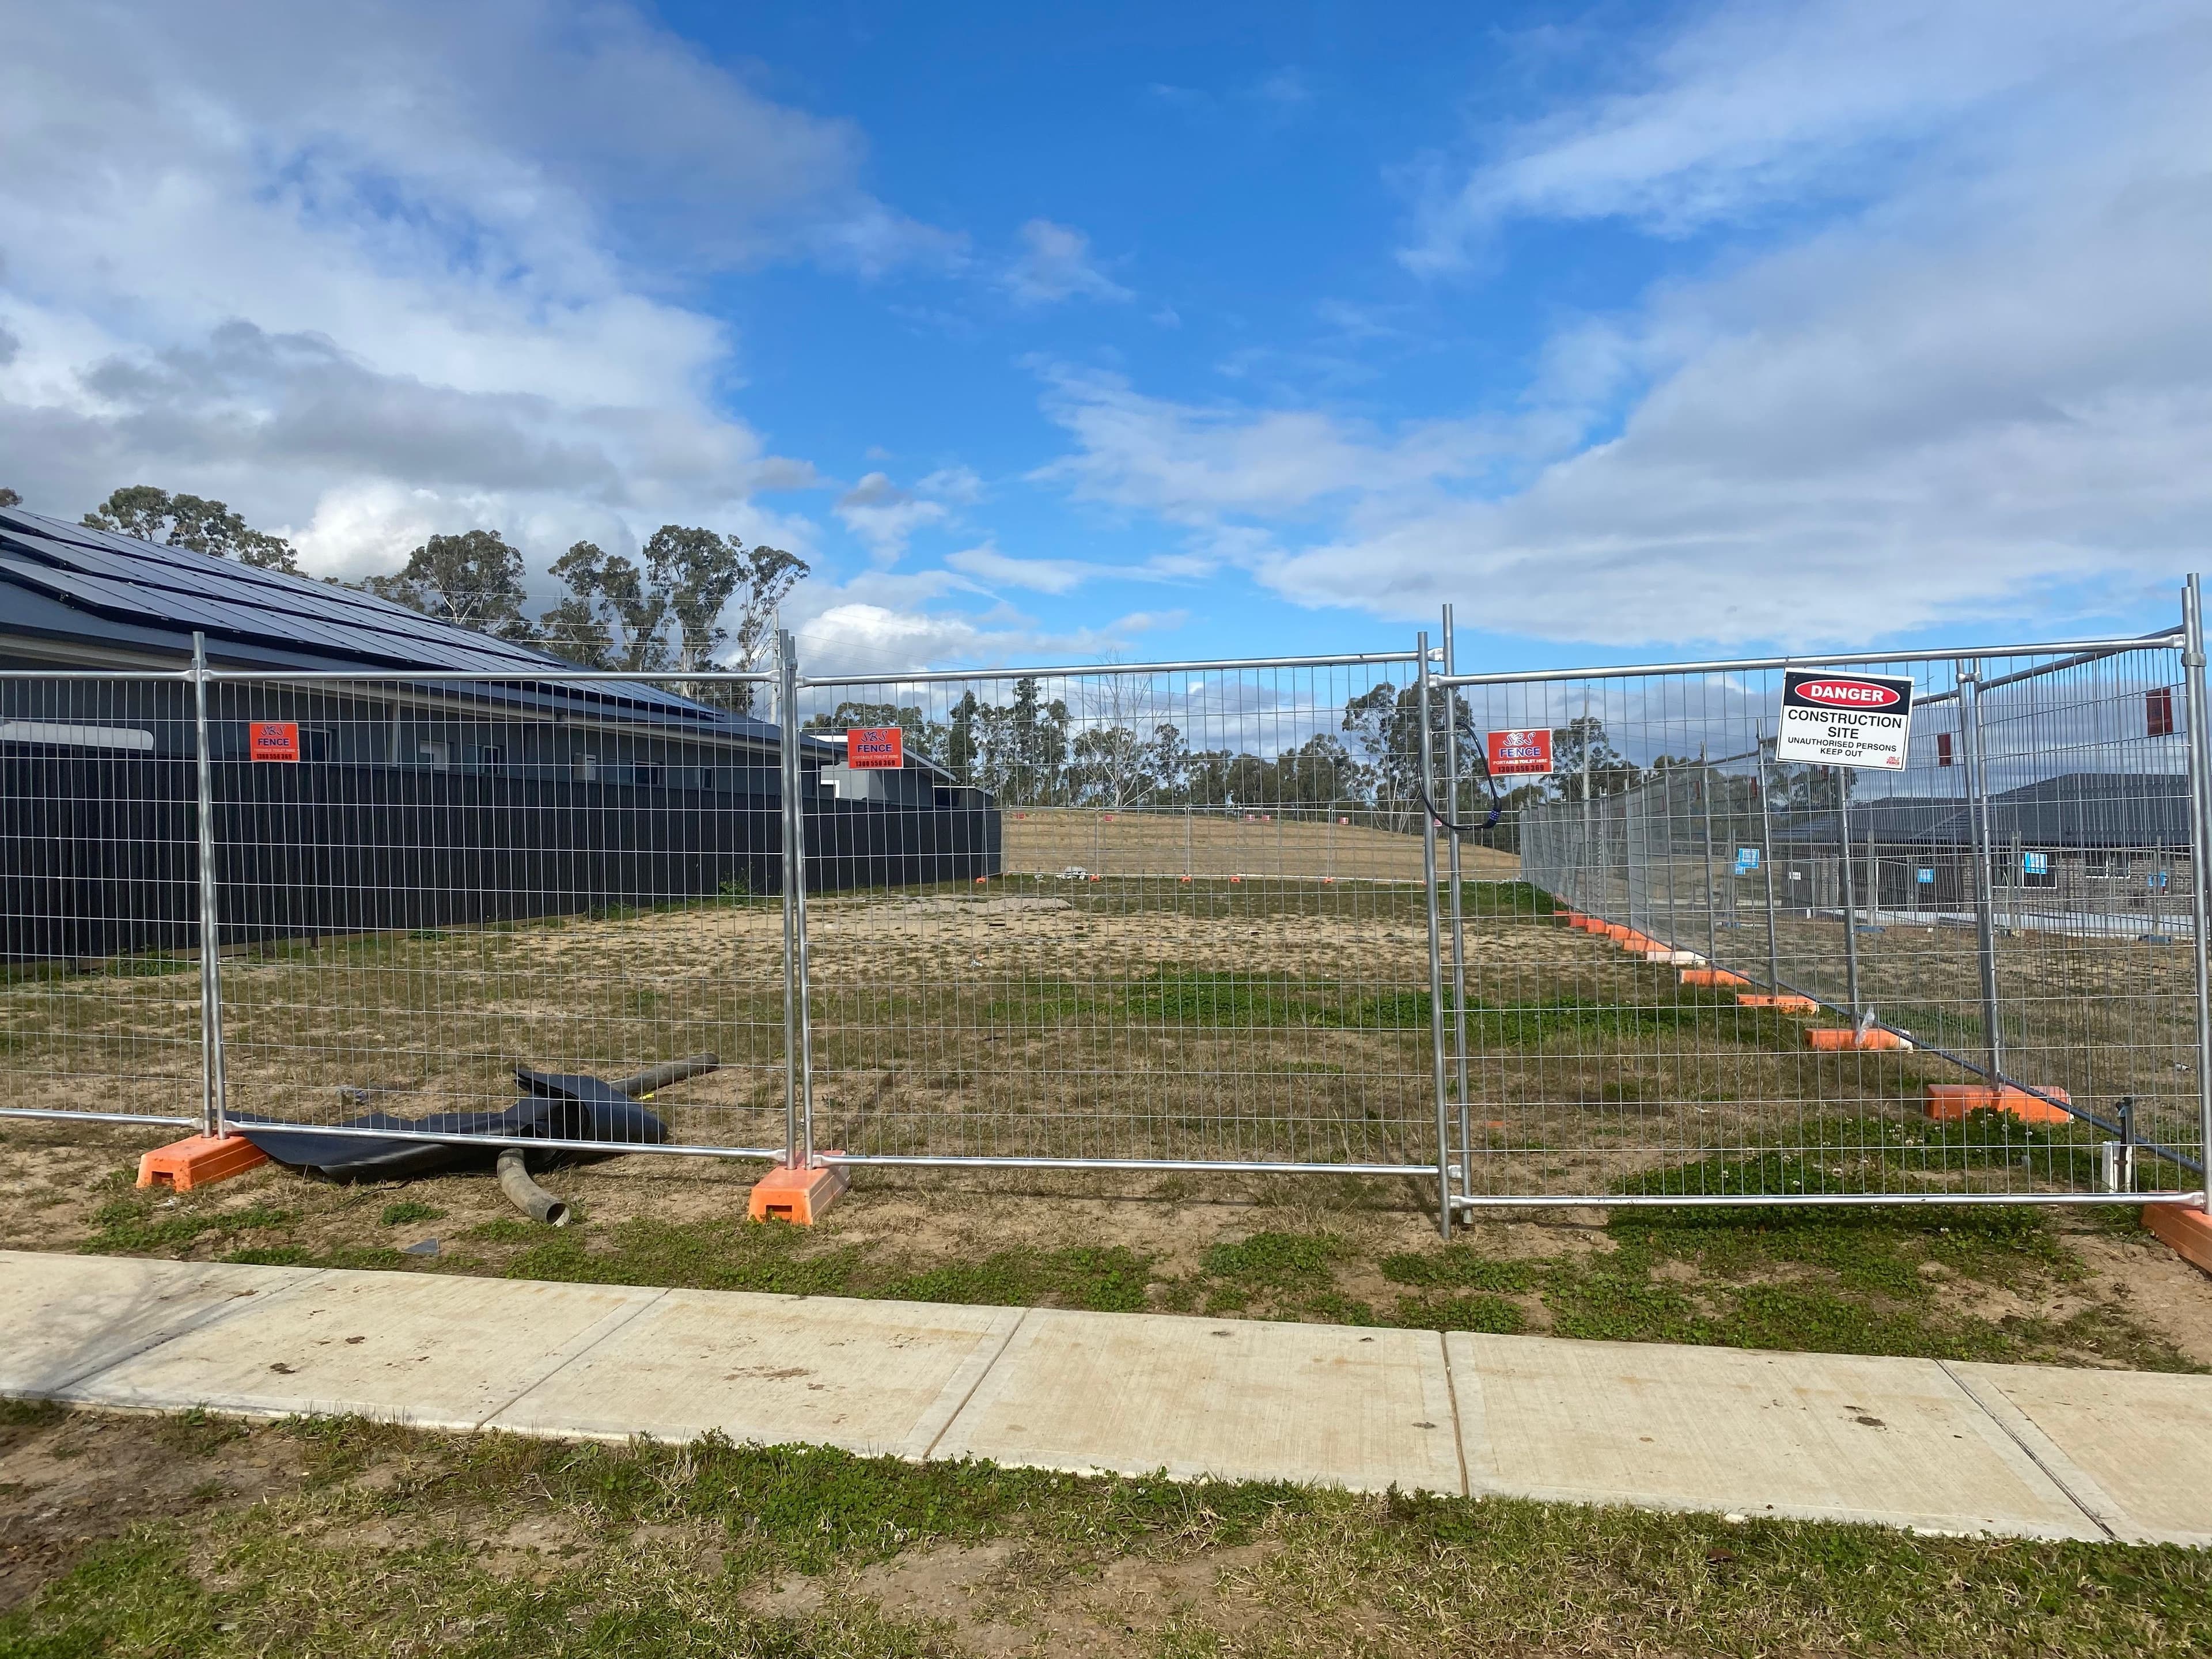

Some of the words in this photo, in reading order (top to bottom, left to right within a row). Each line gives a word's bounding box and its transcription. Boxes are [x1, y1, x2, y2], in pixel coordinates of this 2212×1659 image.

[1810, 685, 1884, 702] DANGER
[1788, 709, 1902, 728] CONSTRUCTION
[861, 730, 888, 742] SBS
[1827, 726, 1859, 739] SITE
[257, 738, 289, 746] FENCE
[1503, 732, 1535, 746] SBS
[1787, 736, 1854, 748] UNAUTHORISED
[1856, 742, 1897, 752] PERSONS
[857, 744, 892, 753] FENCE
[1499, 747, 1541, 757] FENCE
[1845, 749, 1863, 757] OUT
